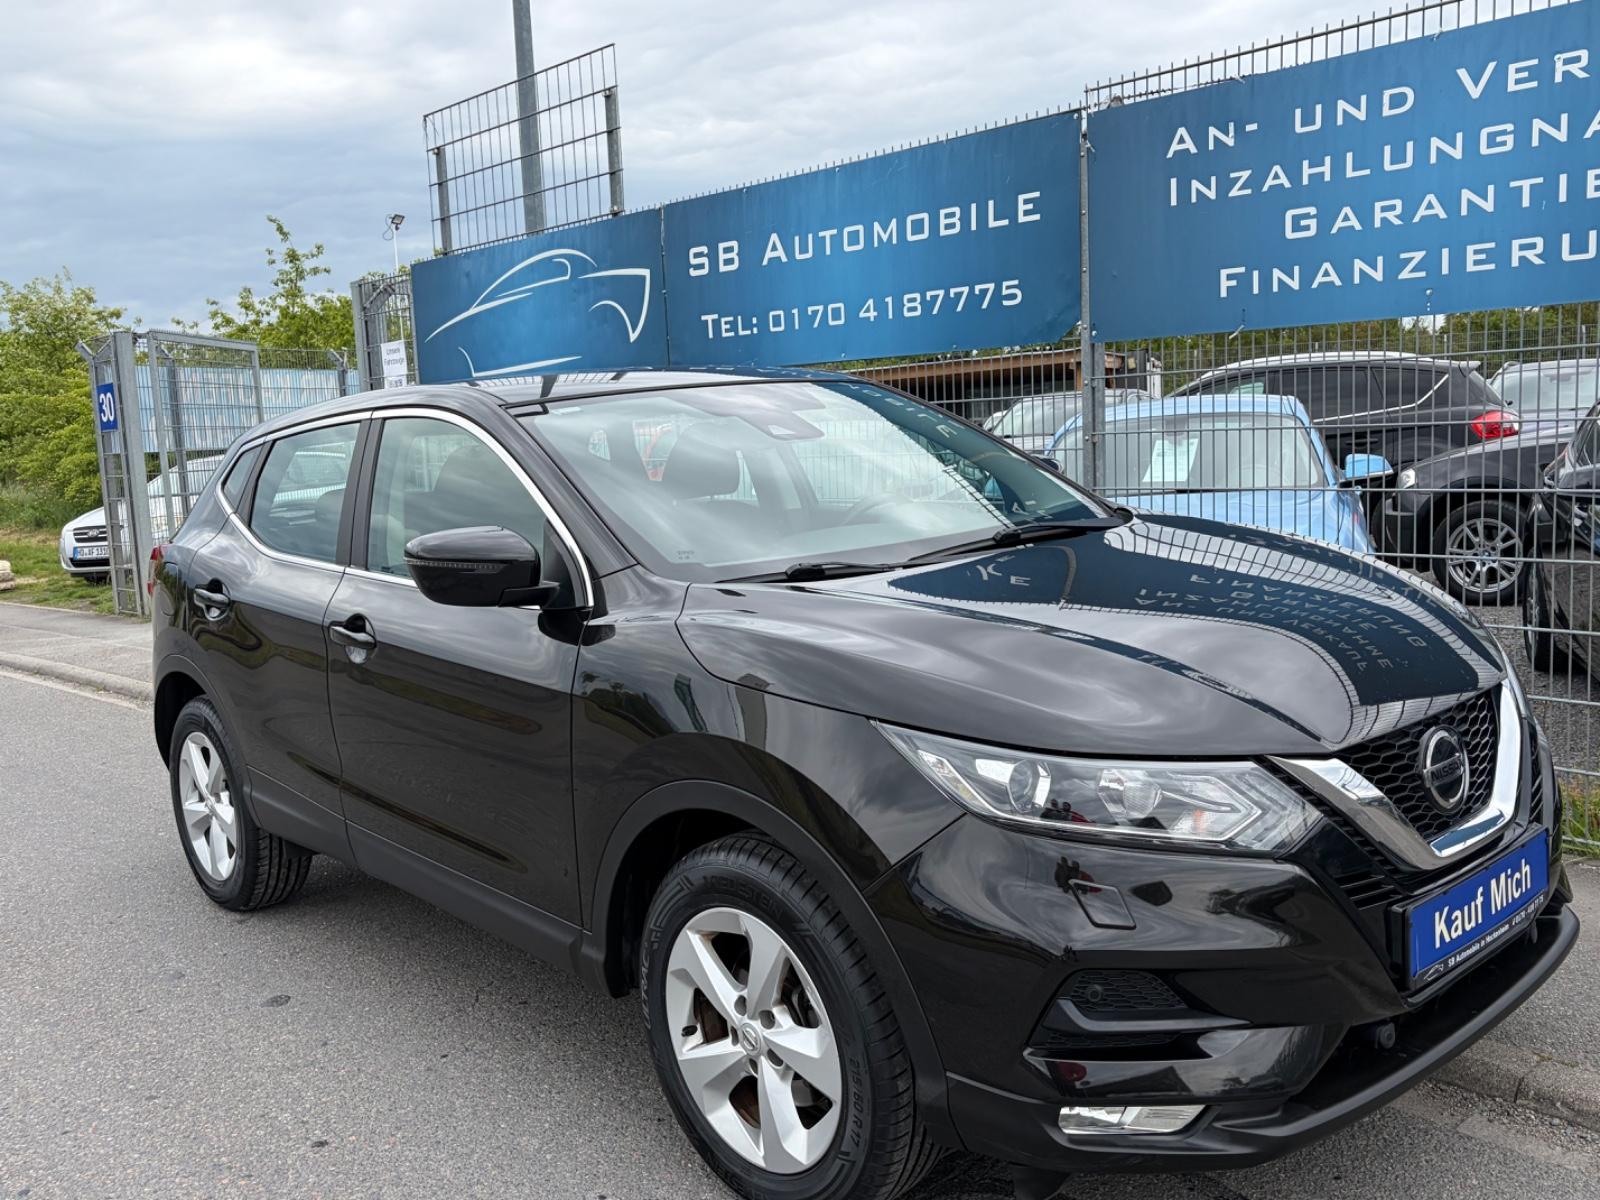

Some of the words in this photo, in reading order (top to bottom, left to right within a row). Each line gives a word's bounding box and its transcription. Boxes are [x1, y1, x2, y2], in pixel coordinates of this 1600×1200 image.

[1294, 86, 1415, 134] UND
[1455, 48, 1591, 100] VER
[688, 240, 740, 277] SB
[762, 191, 1041, 266] AUTOMOBILE
[1219, 229, 1598, 298] FINANZIERU
[700, 312, 759, 339] TEL:
[768, 302, 845, 333] 0170
[858, 279, 1023, 321] 4187775
[99, 392, 115, 422] 30
[1434, 885, 1484, 950] Kauf
[1489, 857, 1532, 916] Mich
